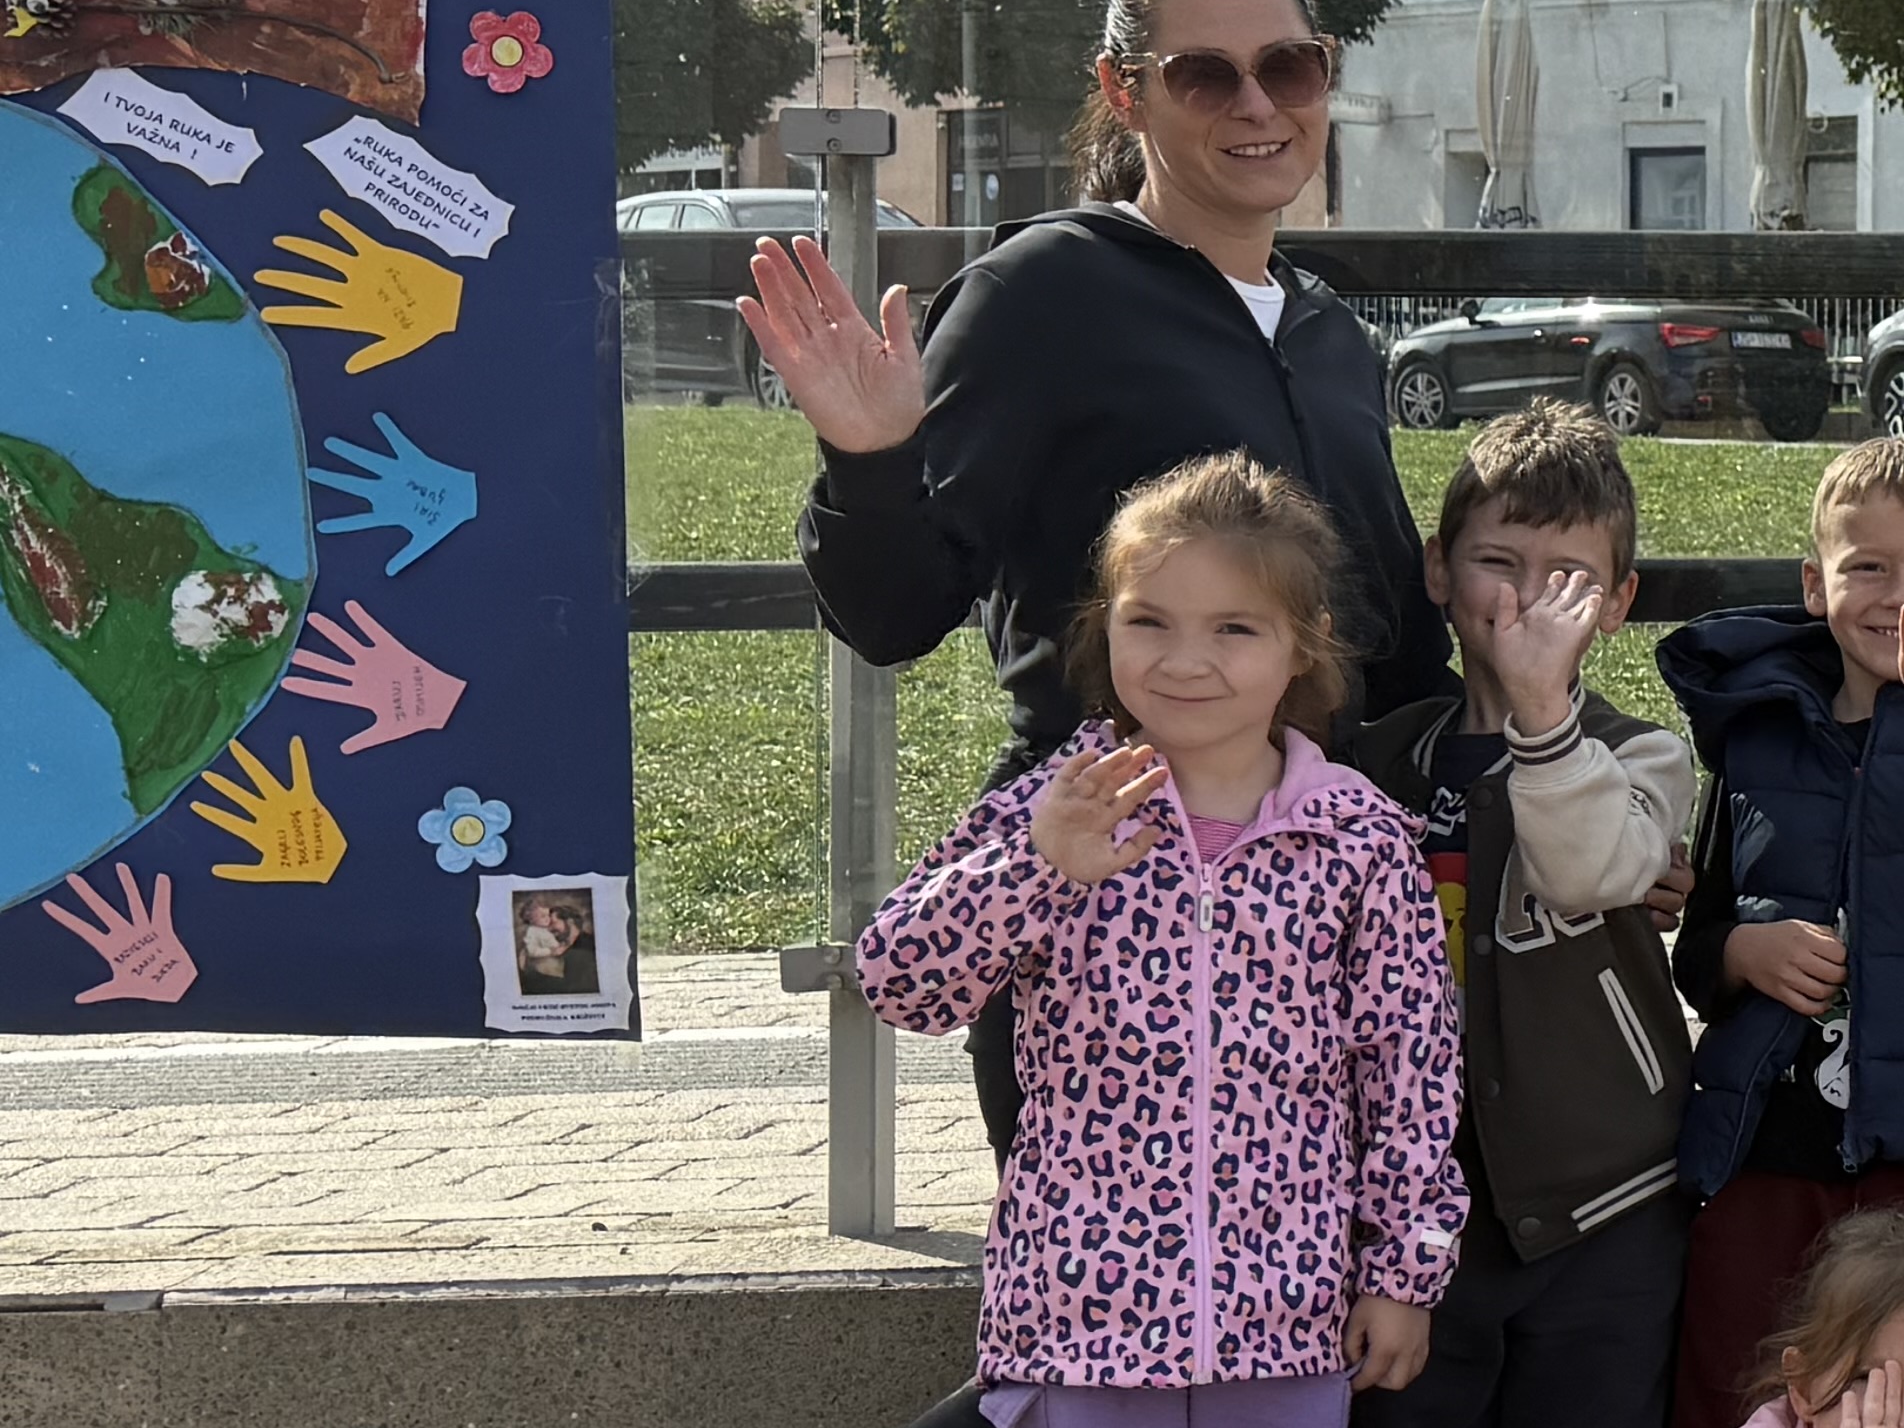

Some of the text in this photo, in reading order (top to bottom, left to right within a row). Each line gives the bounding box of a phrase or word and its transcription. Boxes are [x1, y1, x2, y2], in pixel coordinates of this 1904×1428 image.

[104, 91, 236, 154] I TVOJA RUKA JE
[126, 122, 181, 153] VAŽNA
[343, 146, 384, 179] NAŠU
[387, 174, 471, 232] ZAJEDNICU
[407, 162, 468, 207] POMOĆI
[468, 202, 490, 221] ZA
